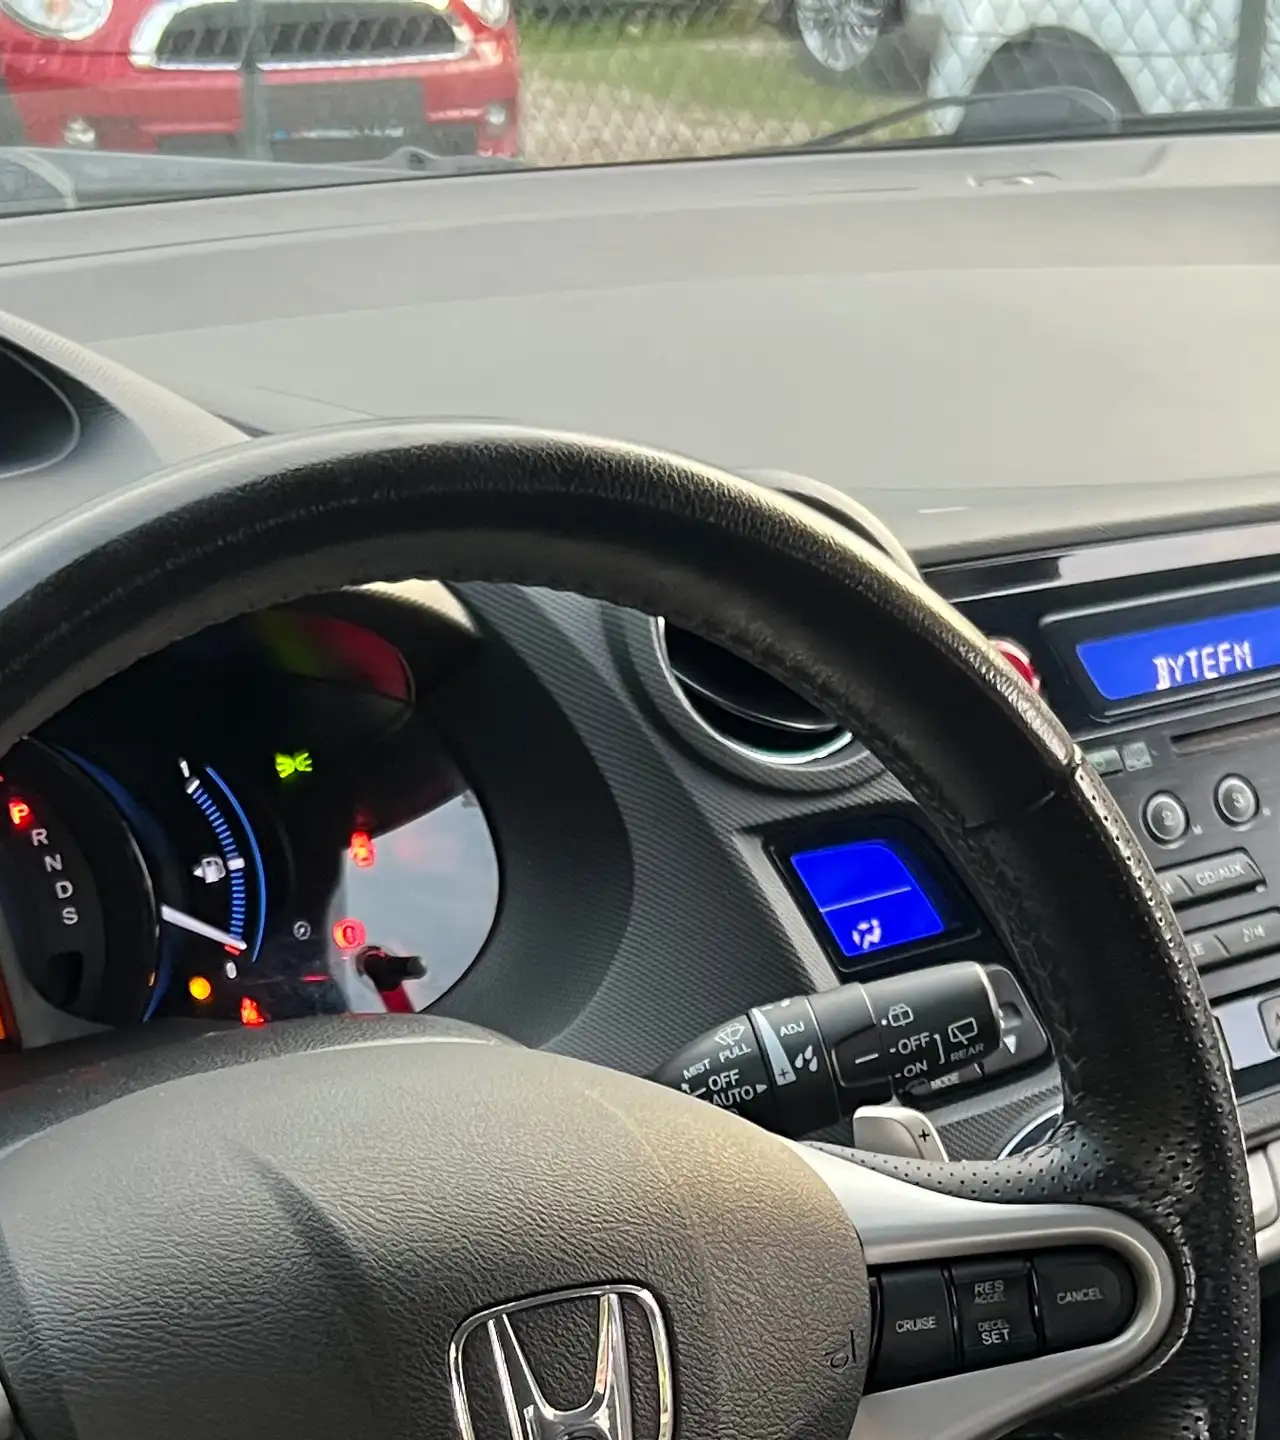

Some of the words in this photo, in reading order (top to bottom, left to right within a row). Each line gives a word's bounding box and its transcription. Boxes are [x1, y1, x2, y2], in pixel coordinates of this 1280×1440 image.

[1152, 640, 1254, 690] BYTEFM
[9, 802, 31, 825] P
[31, 828, 49, 846] R
[44, 853, 63, 872] N
[55, 880, 73, 899] D
[62, 907, 79, 925] S
[779, 1020, 806, 1037] ADJ
[897, 1031, 931, 1055] OFF
[949, 1042, 985, 1063] REAR
[718, 1043, 753, 1063] PULL
[682, 1058, 711, 1081] MIST
[903, 1060, 929, 1078] ON
[708, 1068, 741, 1092] OFF
[930, 1072, 961, 1091] MODE
[711, 1084, 754, 1107] AUTO
[974, 1280, 1005, 1296] RES
[1056, 1287, 1105, 1305] CANCEL
[895, 1315, 938, 1333] CRUISE
[981, 1328, 1011, 1345] SET
